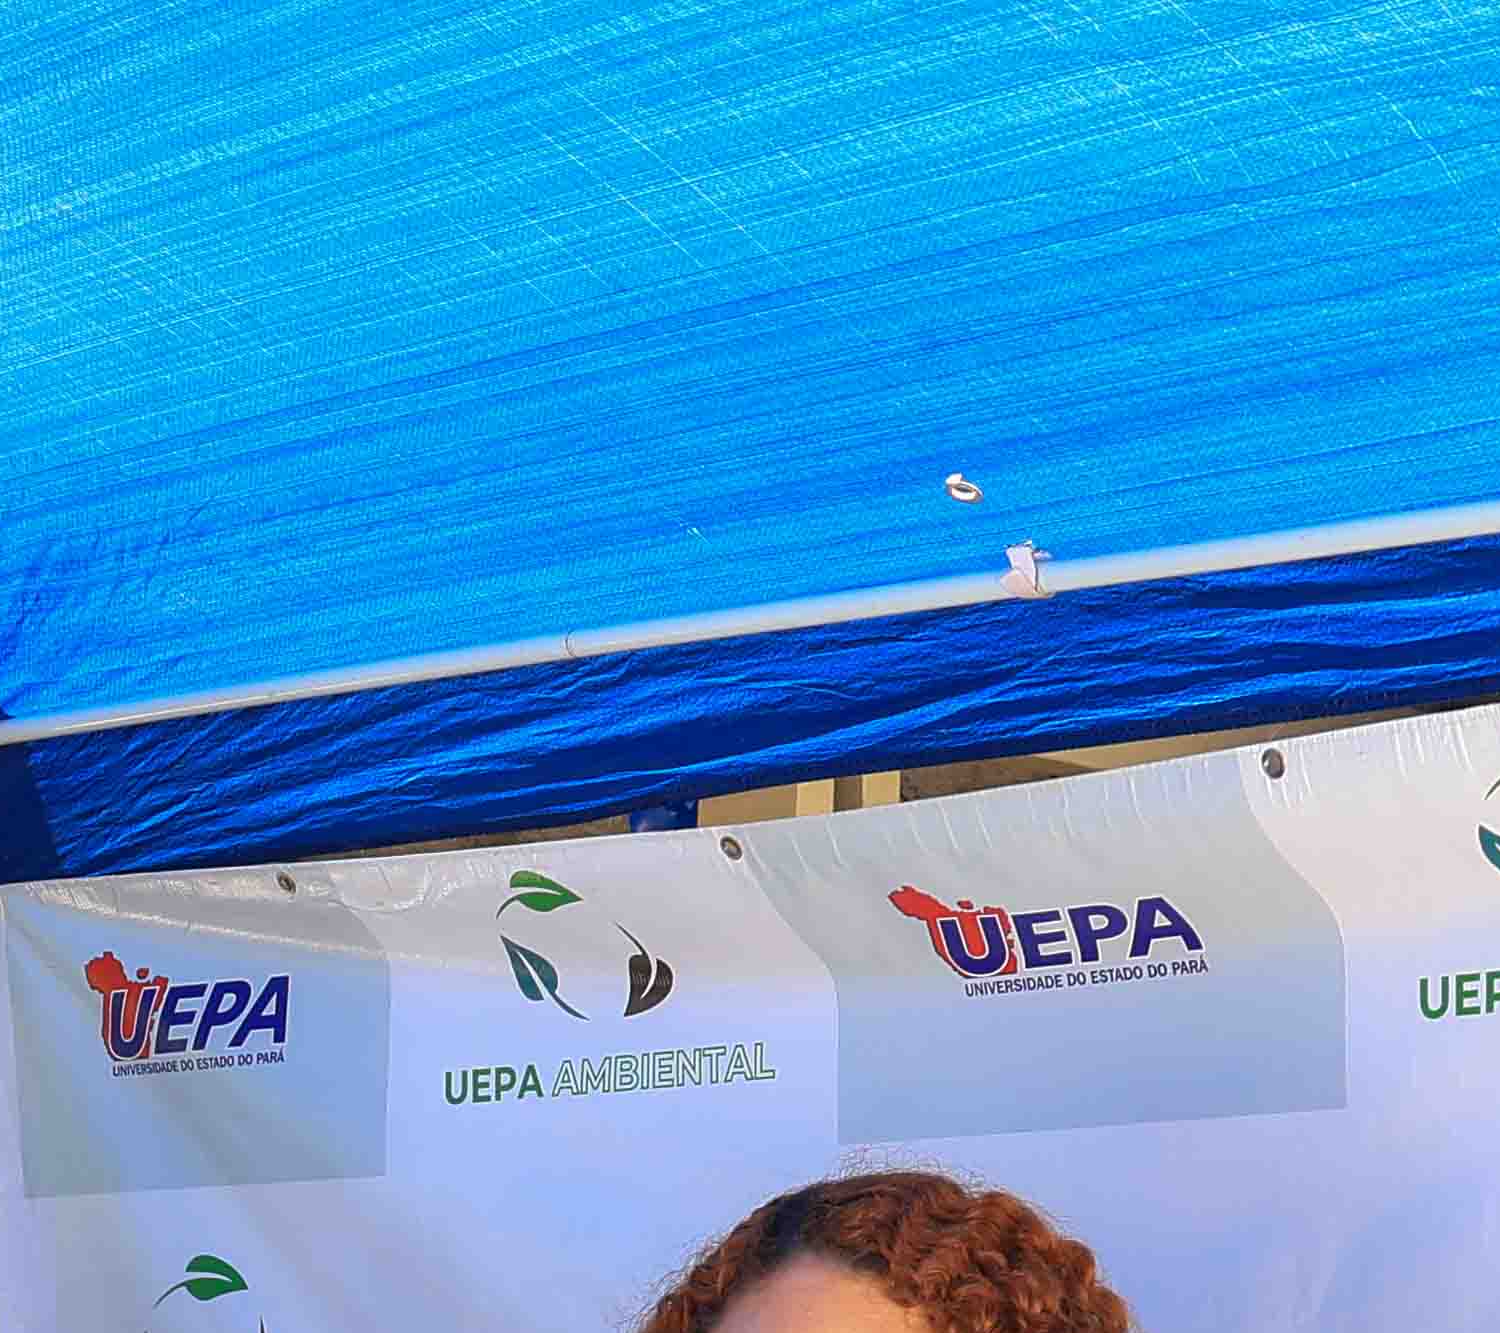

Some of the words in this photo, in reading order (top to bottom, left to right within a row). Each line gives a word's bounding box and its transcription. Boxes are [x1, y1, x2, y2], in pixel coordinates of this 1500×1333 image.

[937, 896, 1205, 976] UEPA
[964, 974, 1064, 998] UNIVERSIDADE
[1067, 971, 1087, 988] DO
[1091, 965, 1144, 984] ESTADO
[1147, 962, 1168, 979] DO
[1172, 954, 1210, 975] PARÁ
[109, 975, 292, 1060] UEPA
[112, 1059, 180, 1078] UNIVERSIDADE
[181, 1058, 195, 1072] DO
[196, 1055, 235, 1071] ESTADO
[238, 1053, 253, 1067] DO
[256, 1048, 285, 1065] PARÁ
[444, 1064, 545, 1106] UEPA
[551, 1040, 777, 1099] AMBIENTAL
